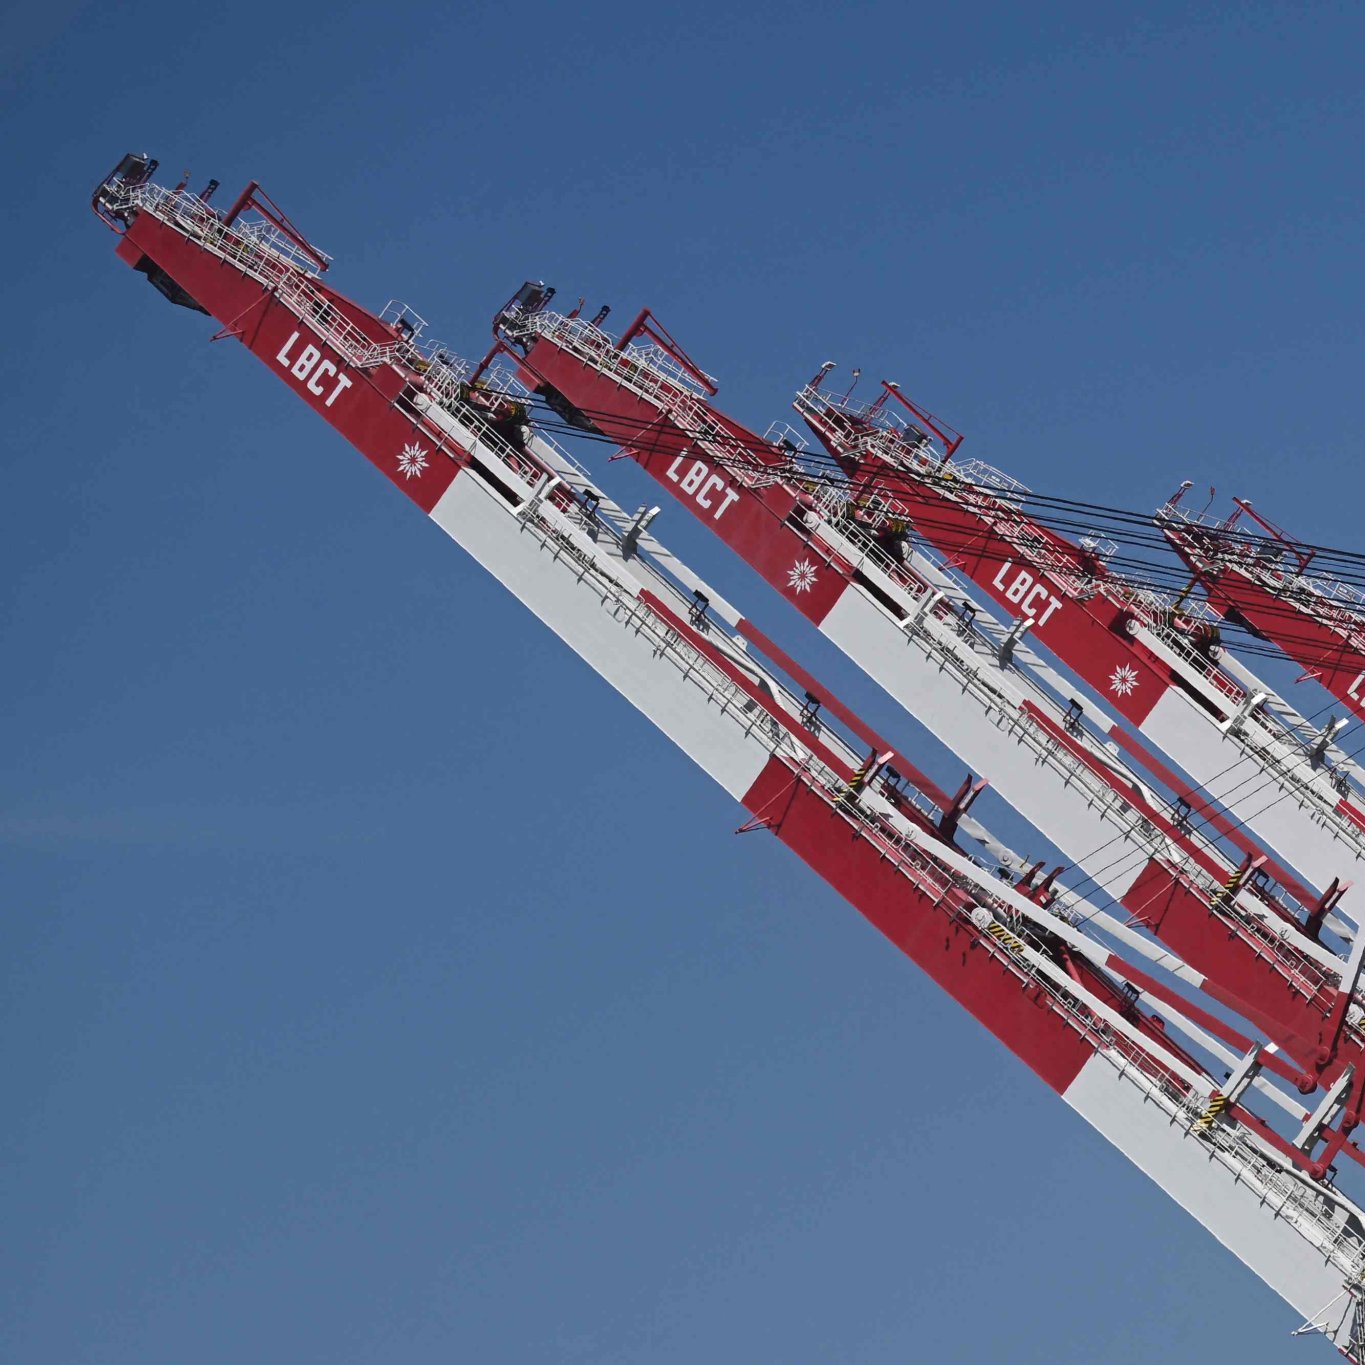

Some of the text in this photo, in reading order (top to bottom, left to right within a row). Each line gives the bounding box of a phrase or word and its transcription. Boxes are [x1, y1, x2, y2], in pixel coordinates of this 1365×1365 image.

[275, 330, 353, 407] LBCT
[665, 447, 740, 520] LBCT
[992, 557, 1063, 627] LBCT
